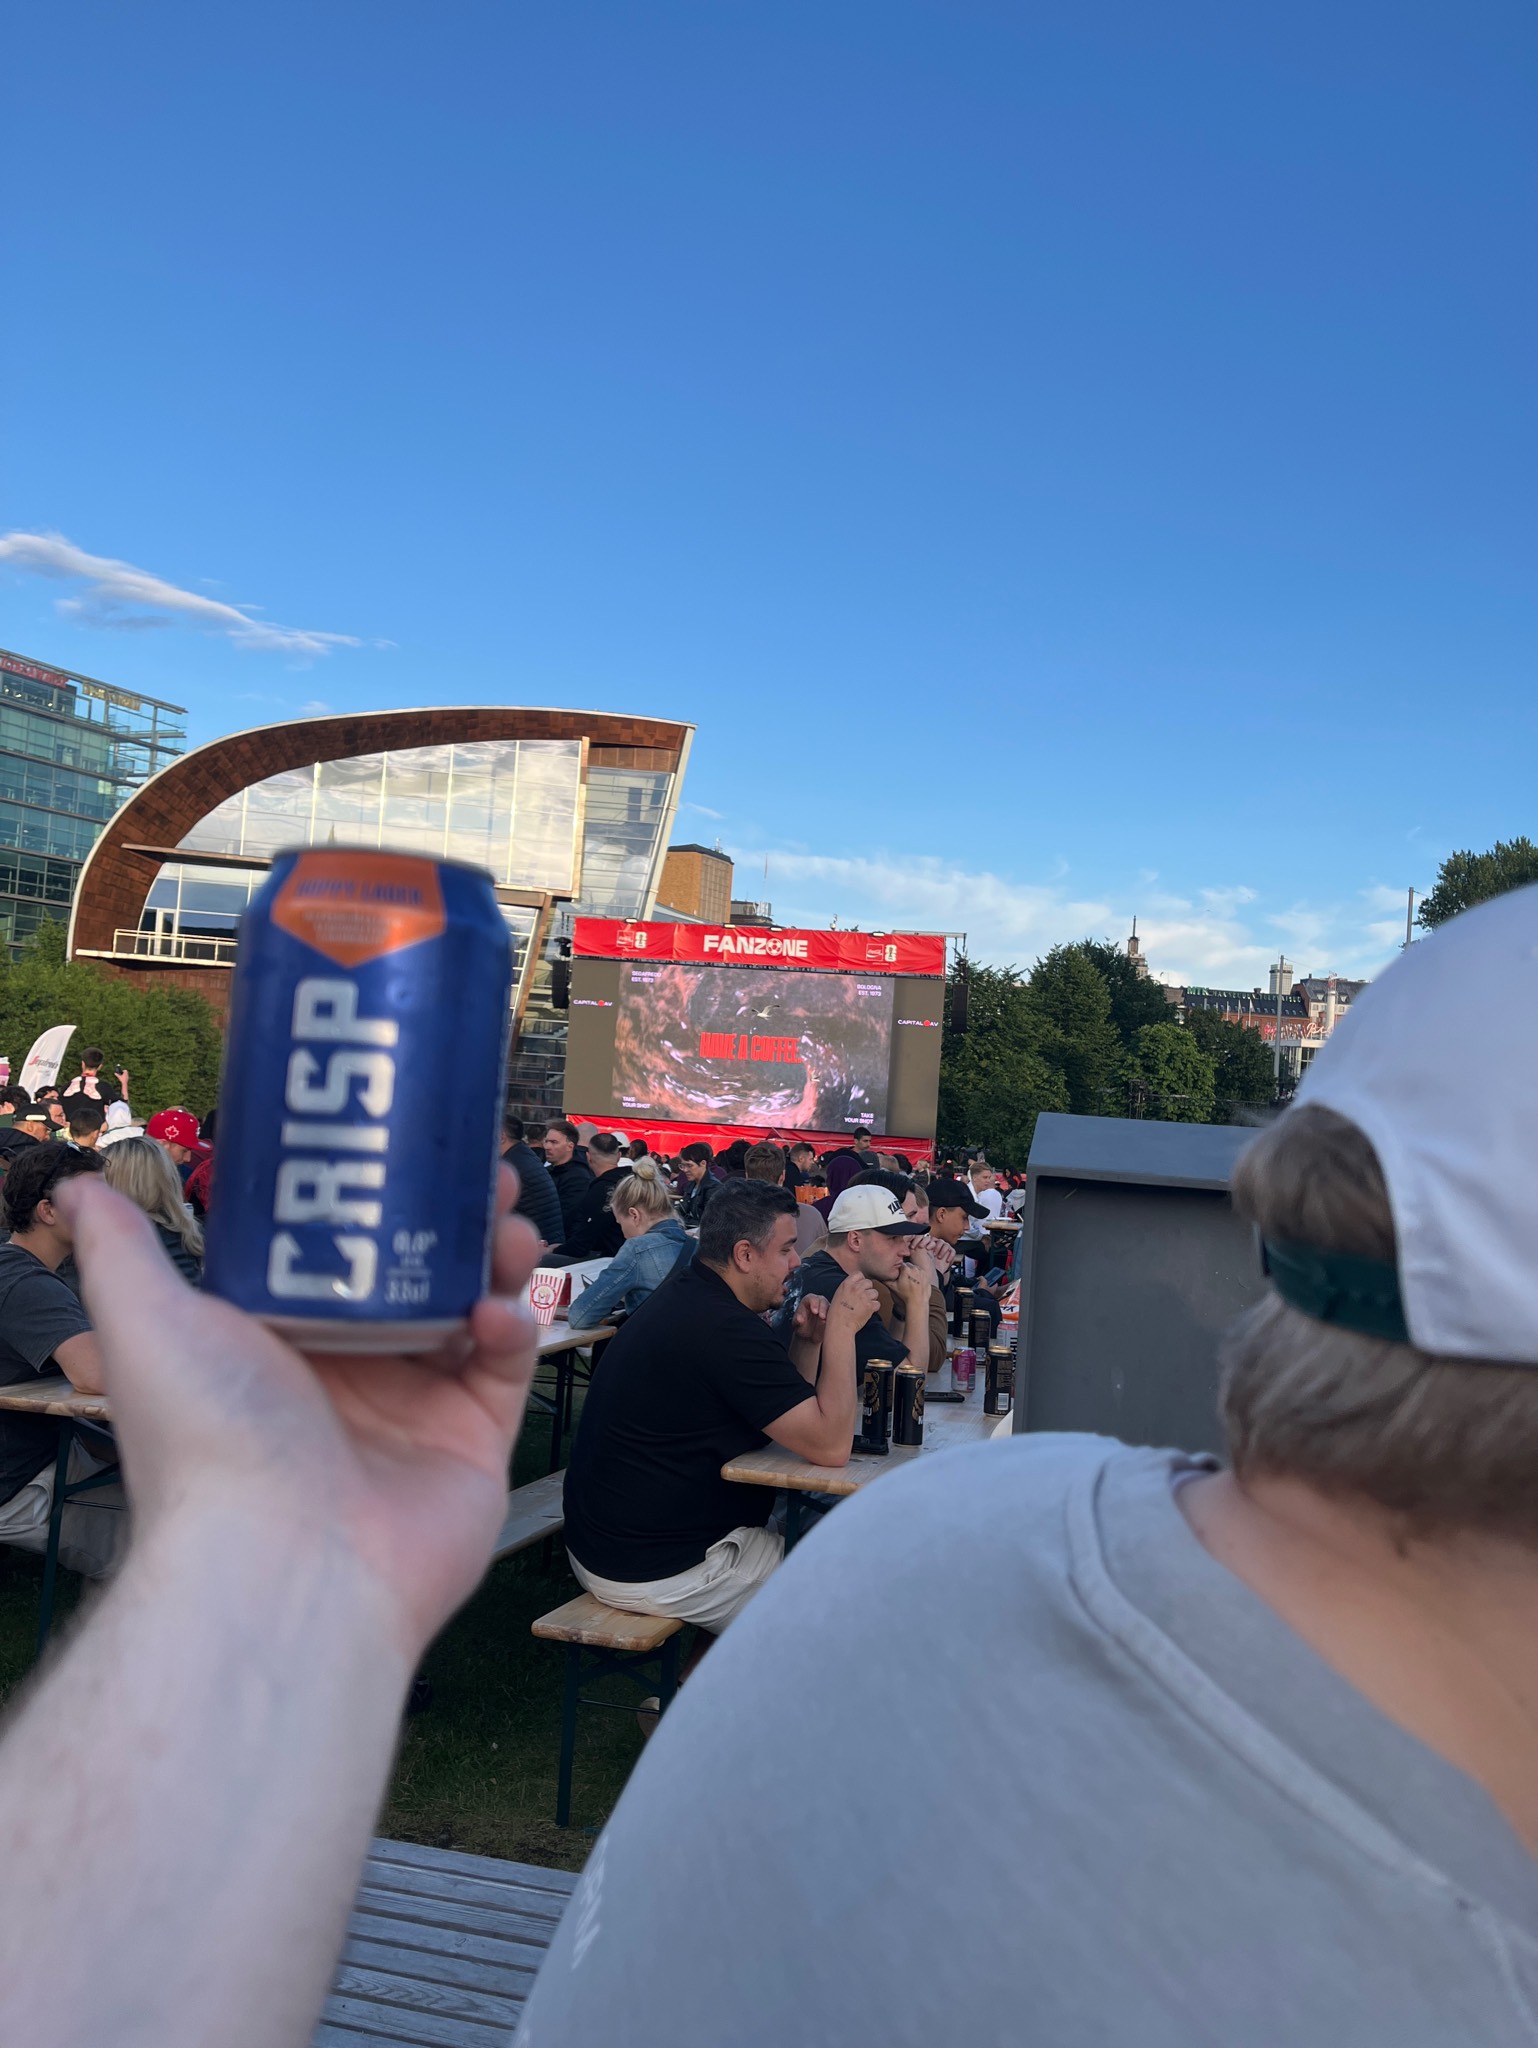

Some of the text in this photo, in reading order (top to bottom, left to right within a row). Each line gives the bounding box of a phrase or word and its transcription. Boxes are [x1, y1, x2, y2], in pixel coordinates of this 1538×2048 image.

[1187, 986, 1209, 996] MTK
[699, 1032, 737, 1060] HAVE
[737, 1034, 749, 1060] A
[266, 976, 399, 1301] CRISP
